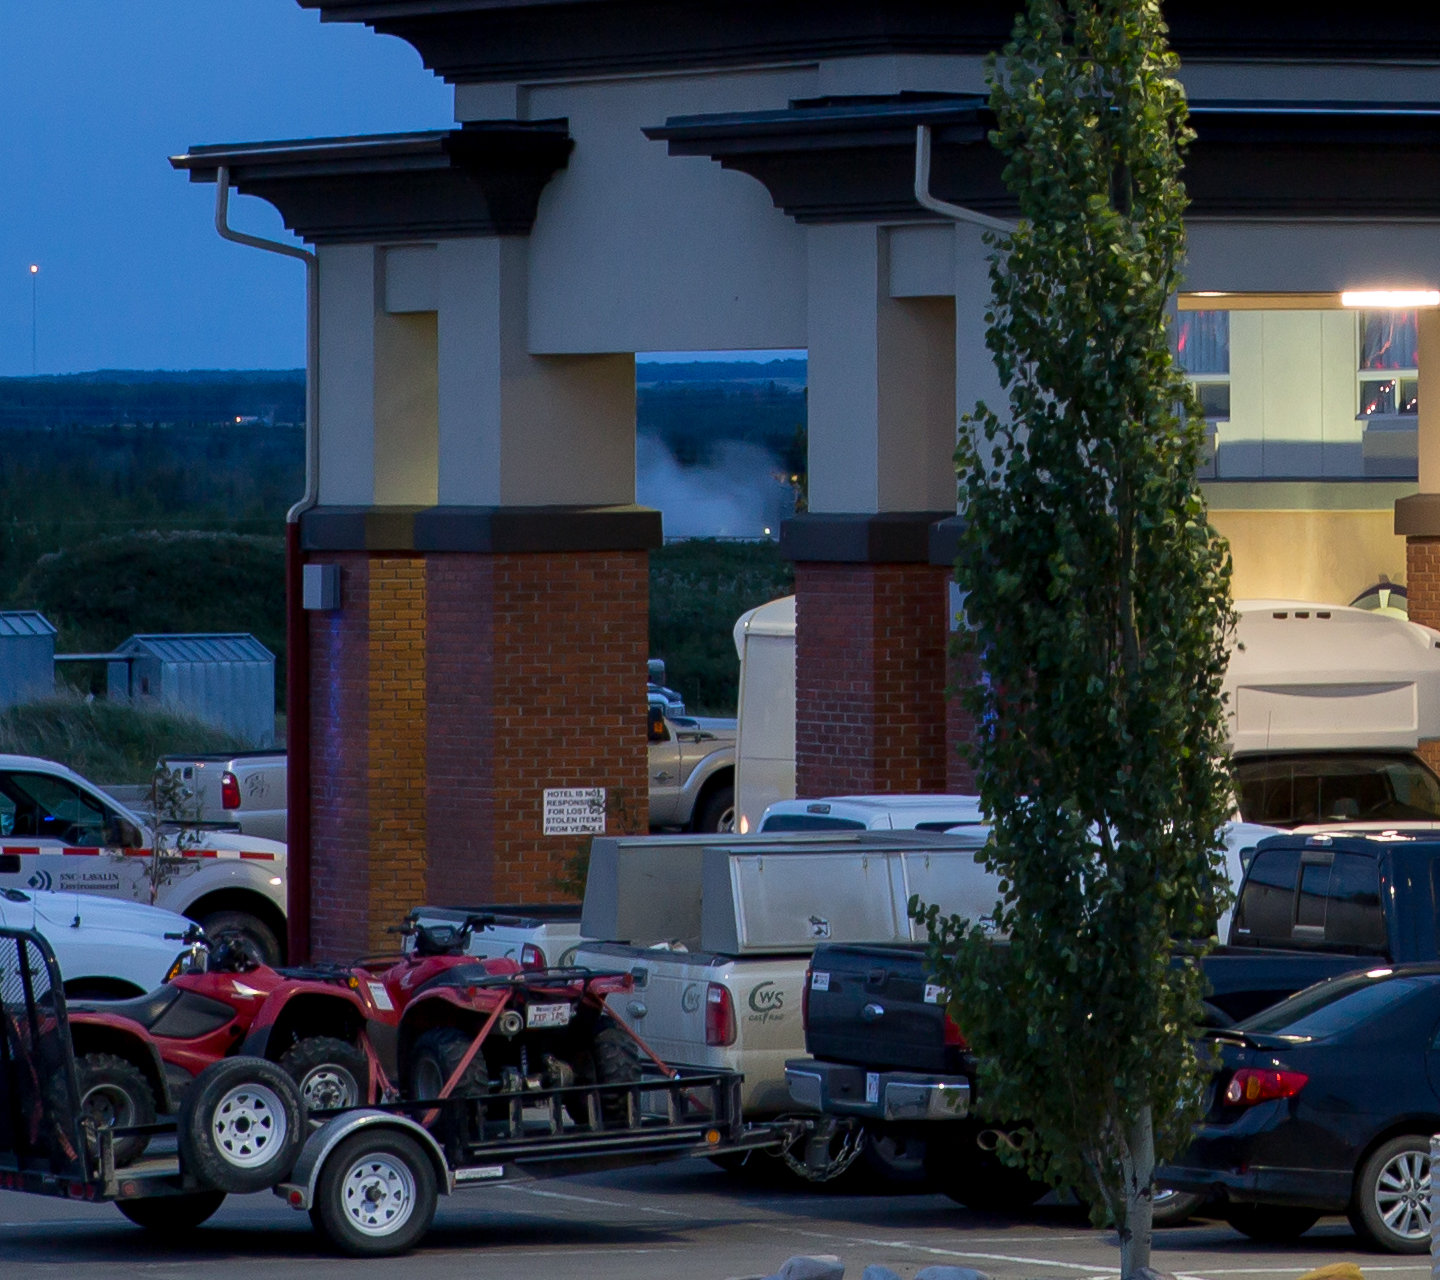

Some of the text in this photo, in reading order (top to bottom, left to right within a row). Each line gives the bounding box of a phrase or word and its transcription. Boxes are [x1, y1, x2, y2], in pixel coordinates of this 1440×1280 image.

[547, 790, 574, 798] HOTEL
[575, 790, 584, 798] IS
[547, 808, 565, 816] FOR
[566, 807, 587, 816] LOST
[546, 816, 603, 825] STOLEN ITEMS
[748, 980, 784, 1013] CWS
